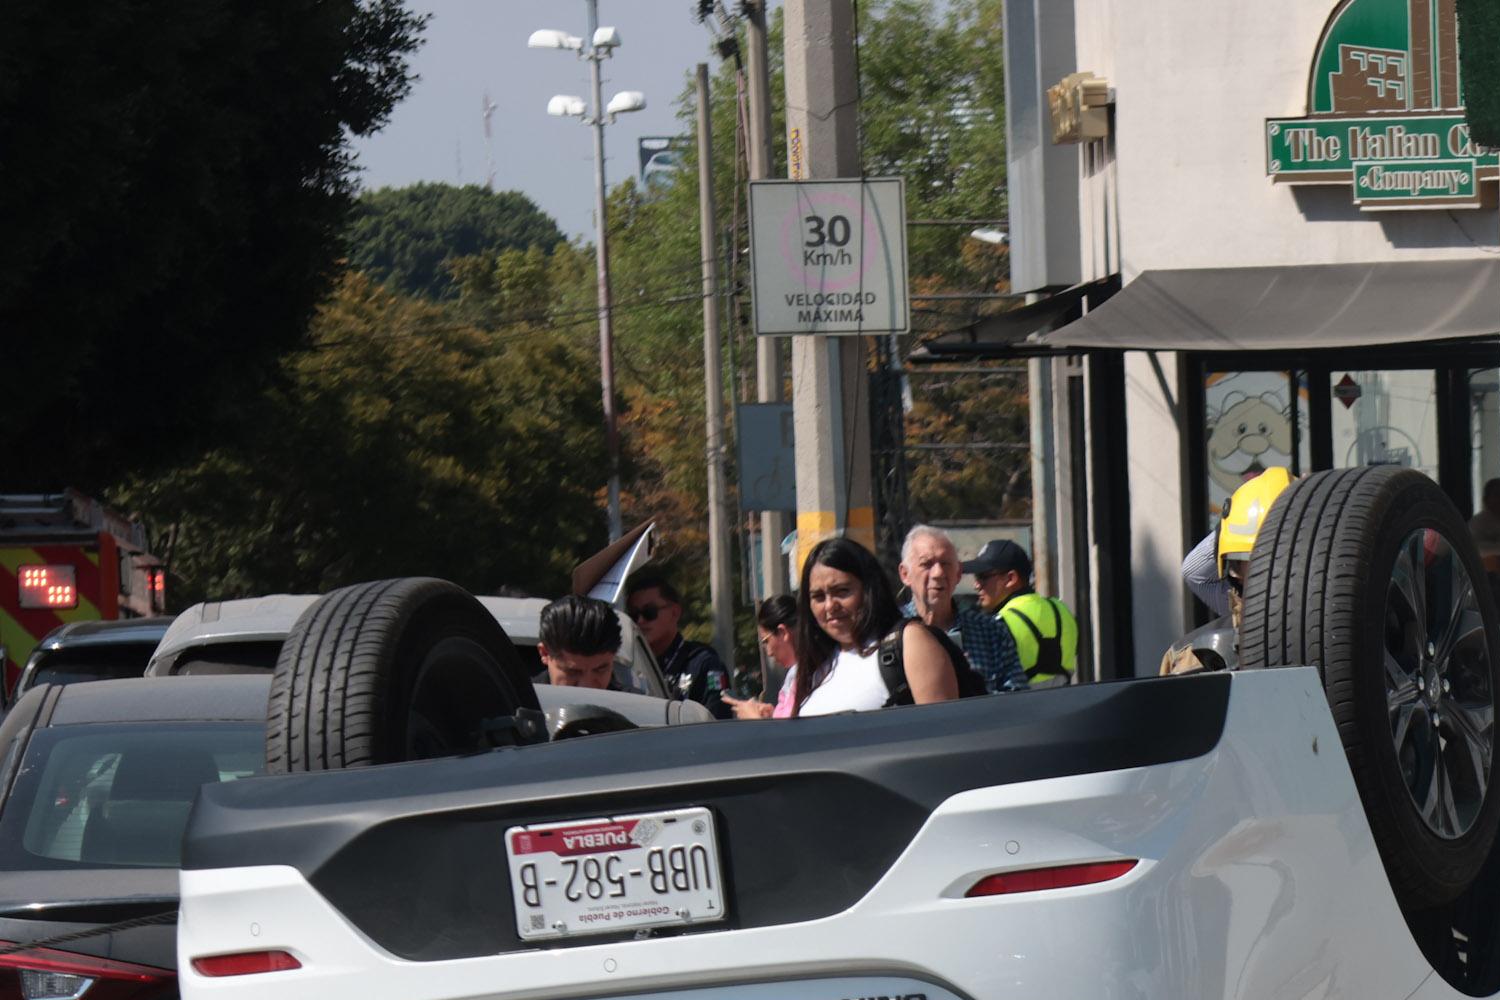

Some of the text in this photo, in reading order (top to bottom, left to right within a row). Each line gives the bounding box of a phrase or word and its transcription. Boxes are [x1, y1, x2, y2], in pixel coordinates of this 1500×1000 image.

[1284, 128, 1341, 163] The
[1348, 125, 1440, 160] Italian
[1366, 166, 1462, 195] Company
[804, 215, 852, 247] 30
[803, 250, 852, 266] Km/h
[785, 292, 876, 306] VELOCIDAD
[562, 831, 628, 850] PUEBLA
[520, 845, 712, 907] UBB-582-B
[578, 912, 611, 923] Puebla
[613, 910, 624, 920] de
[626, 906, 670, 917] Gobierno
